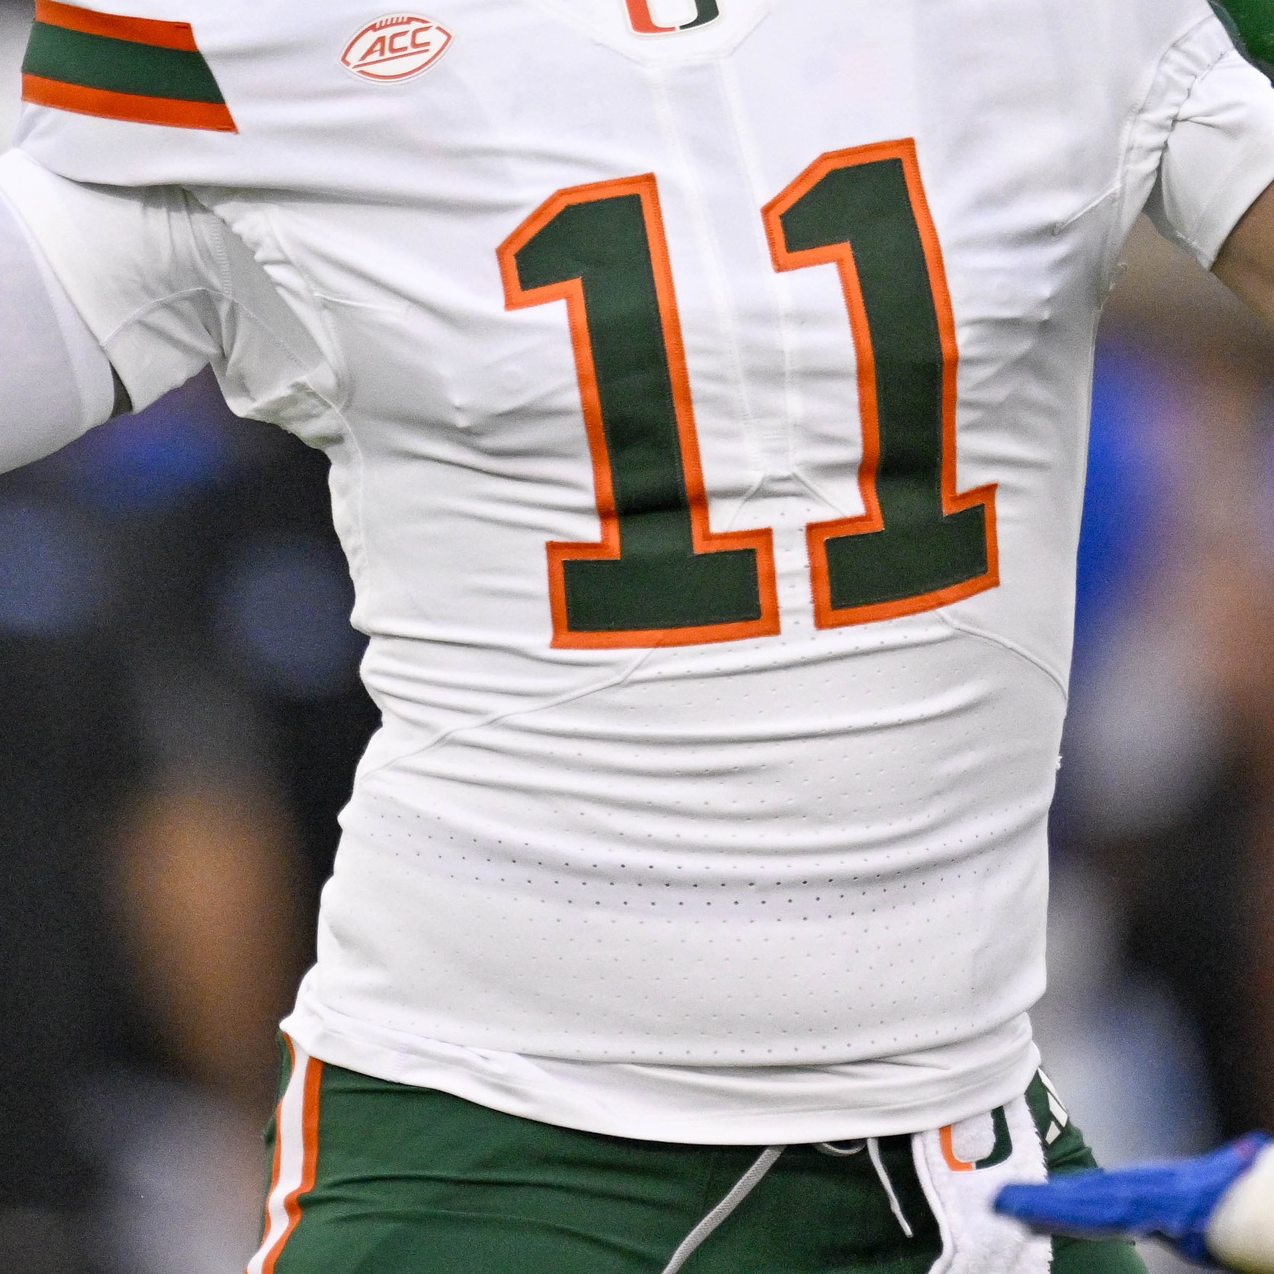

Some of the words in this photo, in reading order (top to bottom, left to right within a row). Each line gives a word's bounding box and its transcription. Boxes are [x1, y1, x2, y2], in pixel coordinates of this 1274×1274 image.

[359, 26, 433, 61] ACC
[496, 137, 1000, 648] 11
[939, 1106, 1012, 1172] U
